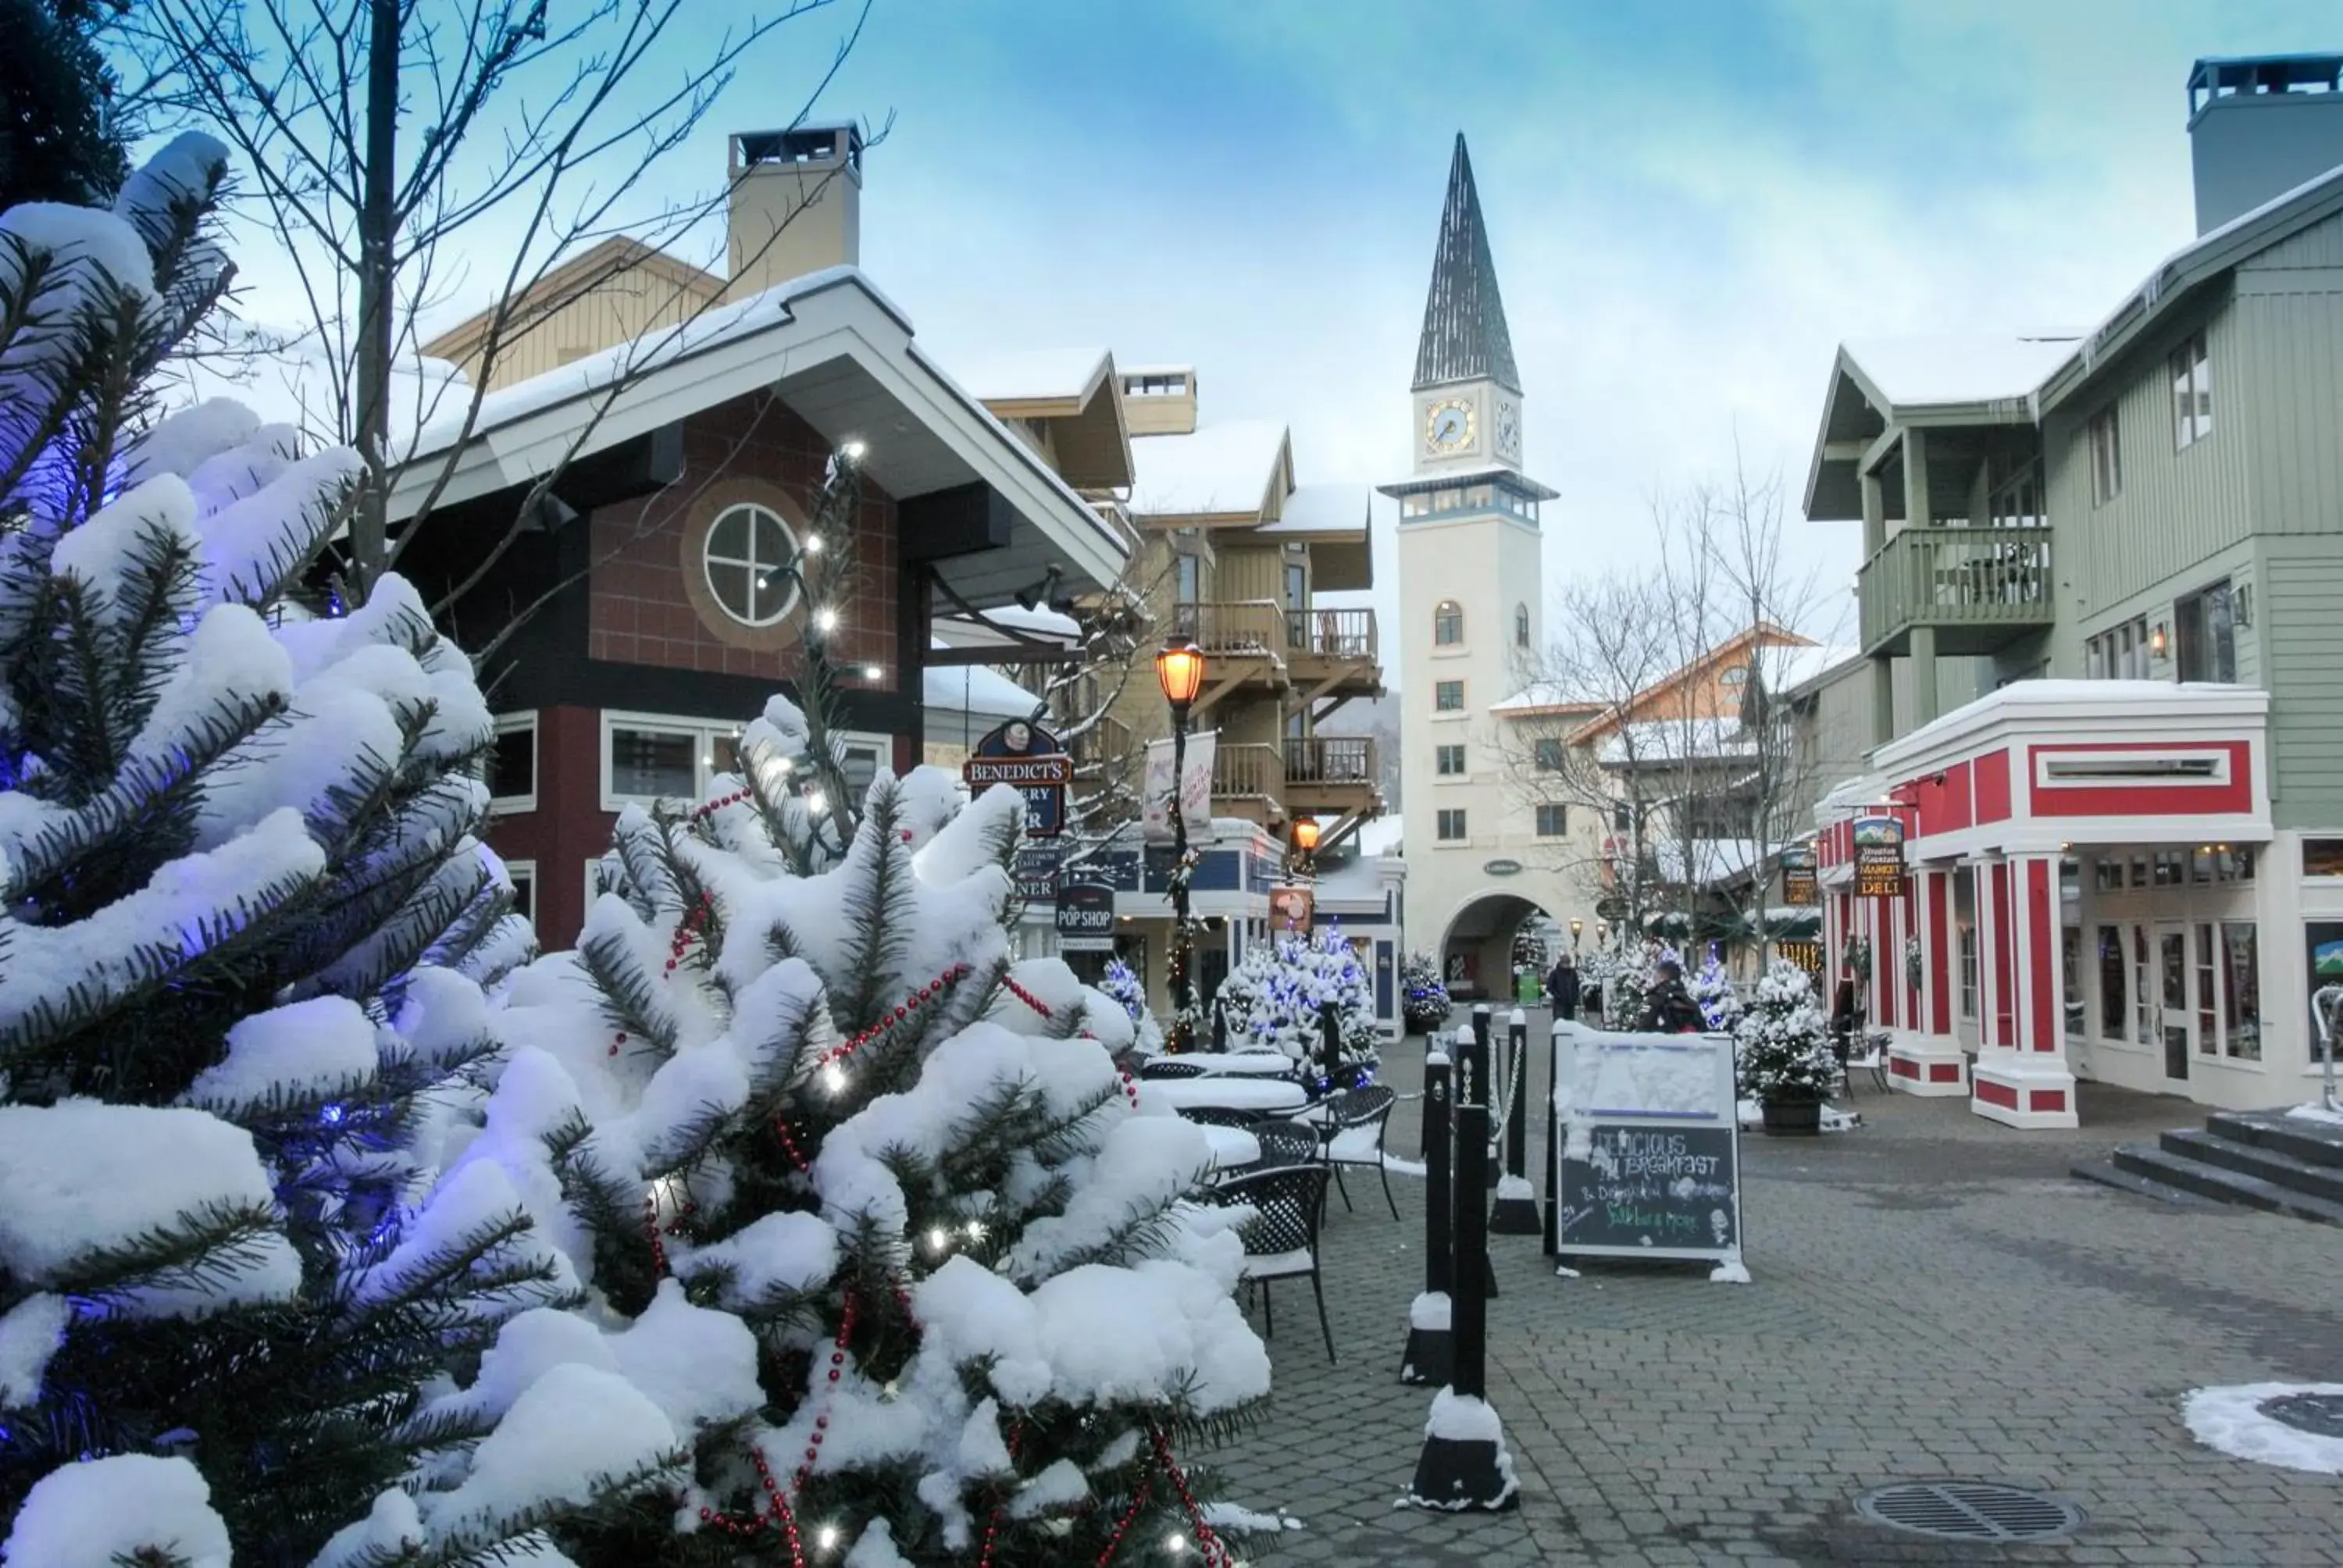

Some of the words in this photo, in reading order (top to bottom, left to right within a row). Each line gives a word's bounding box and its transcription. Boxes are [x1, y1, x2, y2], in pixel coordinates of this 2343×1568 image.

[971, 762, 1062, 780] BENEDICT'S
[1862, 882, 1899, 894] DELI
[1058, 911, 1081, 926] POP
[1082, 911, 1110, 927] SHOP
